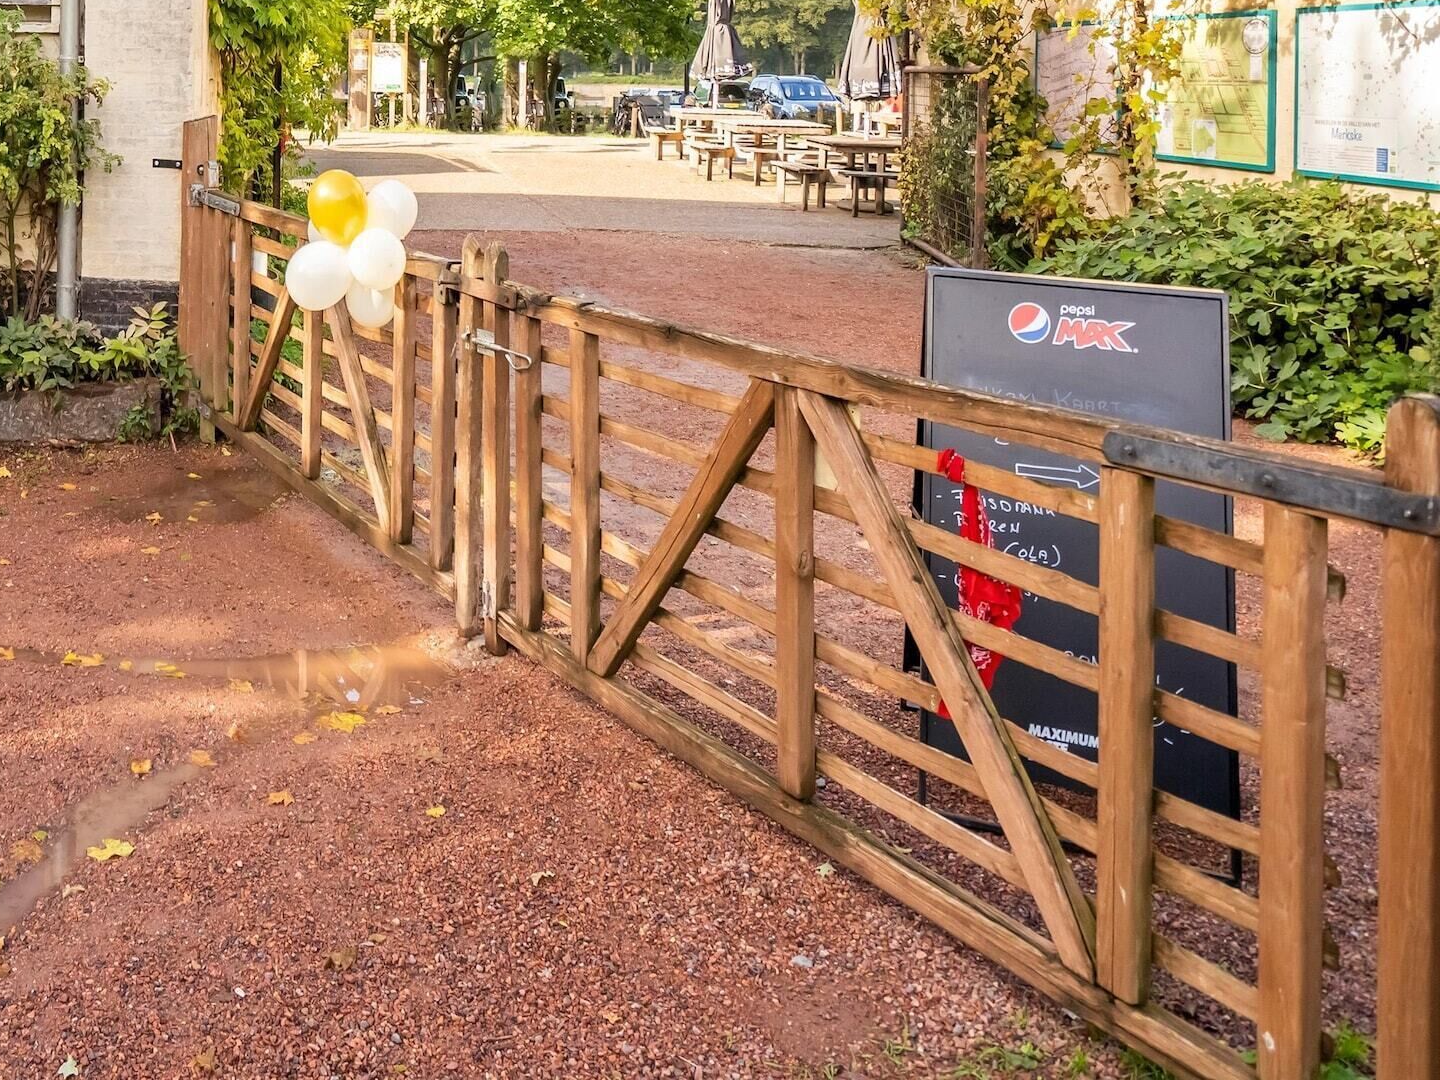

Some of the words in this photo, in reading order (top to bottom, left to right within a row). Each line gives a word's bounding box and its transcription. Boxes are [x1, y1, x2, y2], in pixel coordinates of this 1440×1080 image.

[1060, 304, 1095, 317] pepsi
[1052, 316, 1137, 352] MAX
[1029, 723, 1099, 749] MAXIMUM
